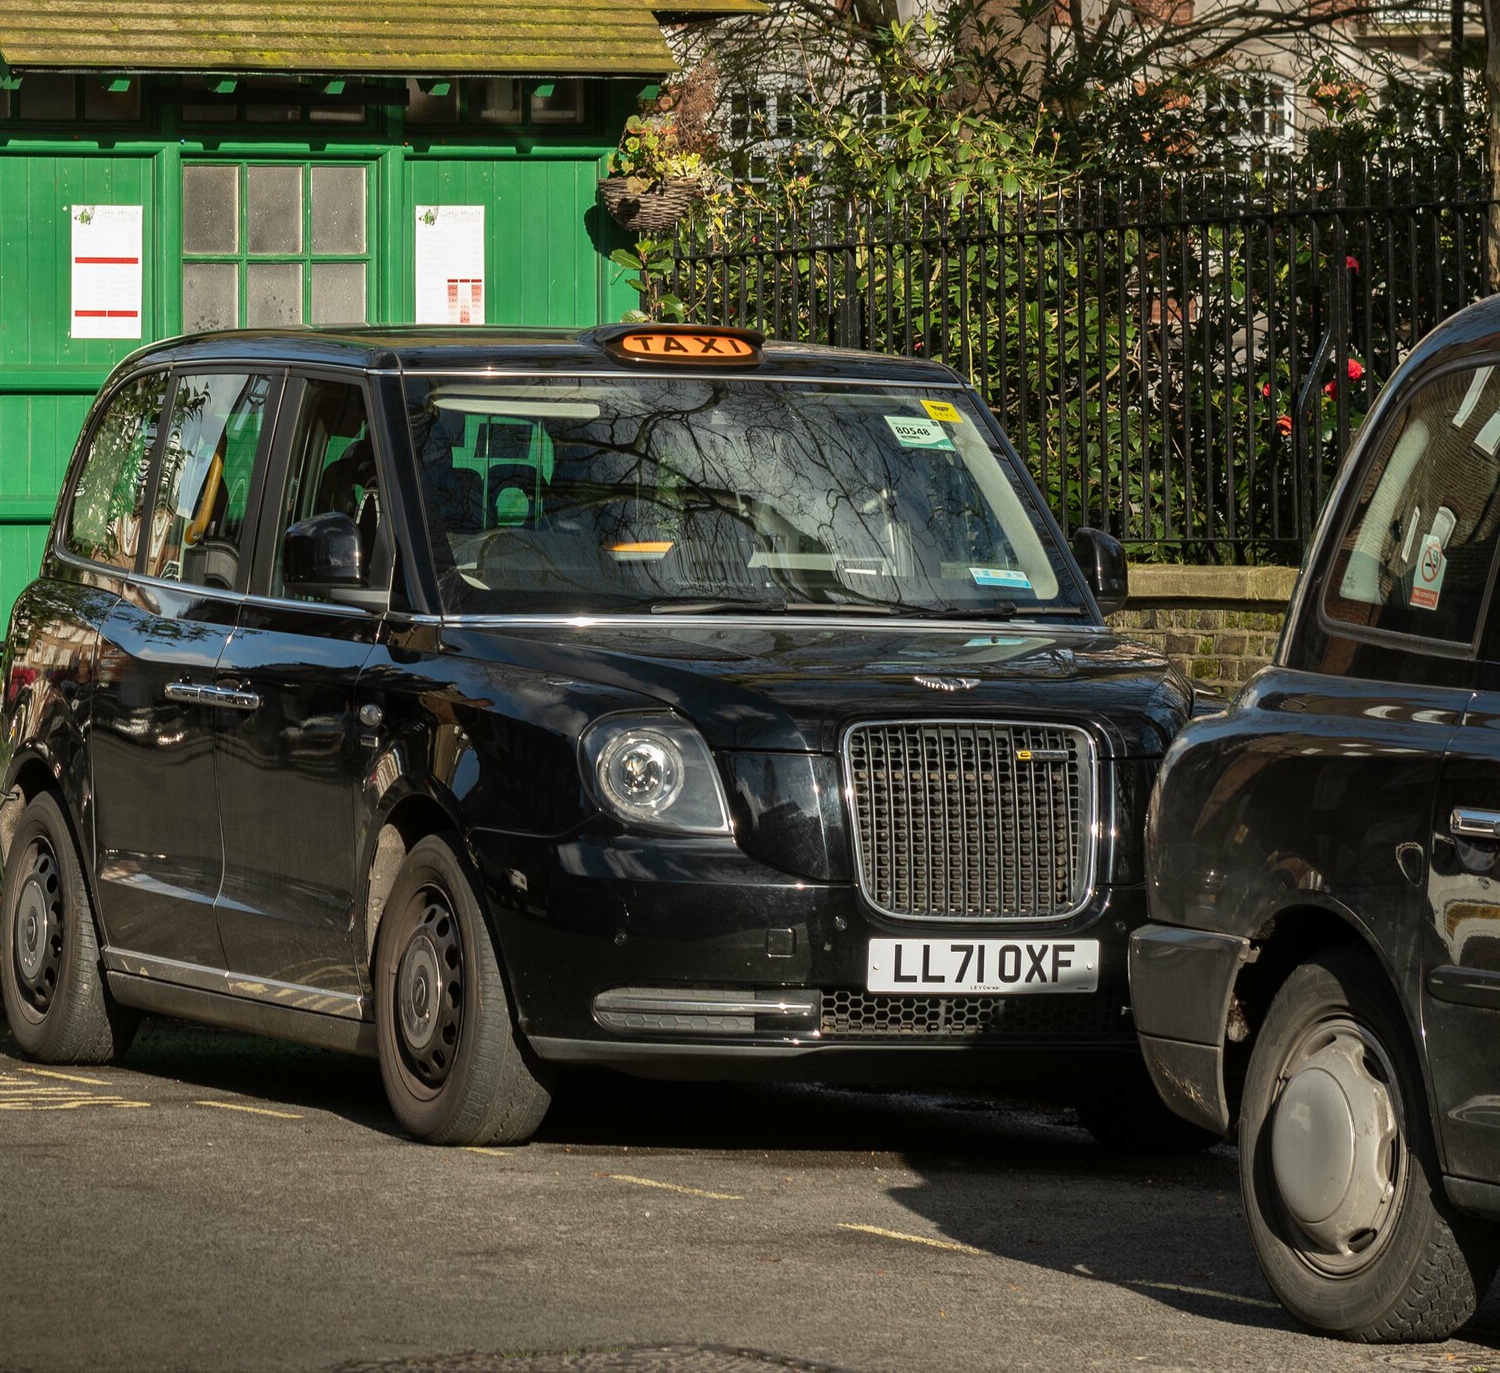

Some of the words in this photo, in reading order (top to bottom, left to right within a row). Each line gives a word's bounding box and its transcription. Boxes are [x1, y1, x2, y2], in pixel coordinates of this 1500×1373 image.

[633, 337, 742, 354] TAXI
[895, 426, 931, 436] 80548
[893, 944, 985, 983] LL71
[998, 944, 1075, 983] OXF
